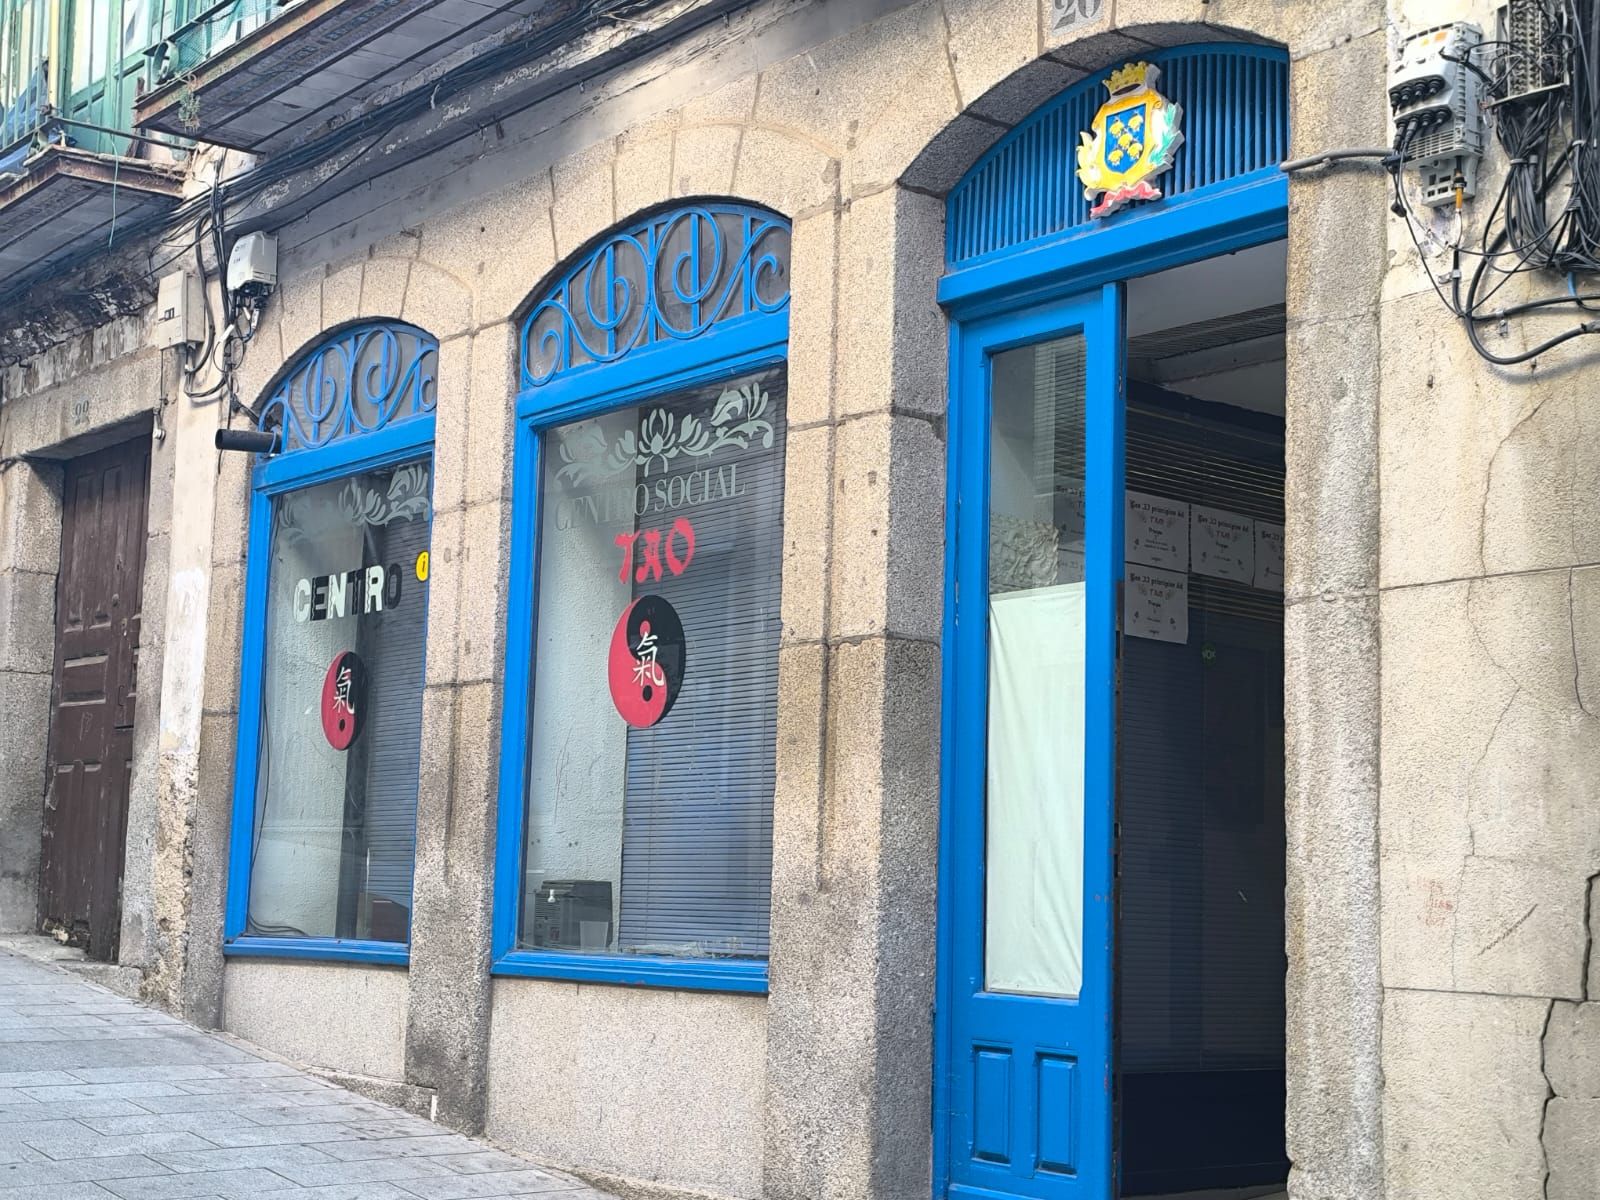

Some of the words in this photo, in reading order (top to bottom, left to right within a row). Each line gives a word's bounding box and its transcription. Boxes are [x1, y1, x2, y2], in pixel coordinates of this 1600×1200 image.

[554, 483, 650, 531] CENTRO
[654, 463, 746, 513] SOCIAL
[614, 517, 695, 585] TAO
[293, 563, 402, 623] CENTRO
[632, 632, 664, 687] 氣
